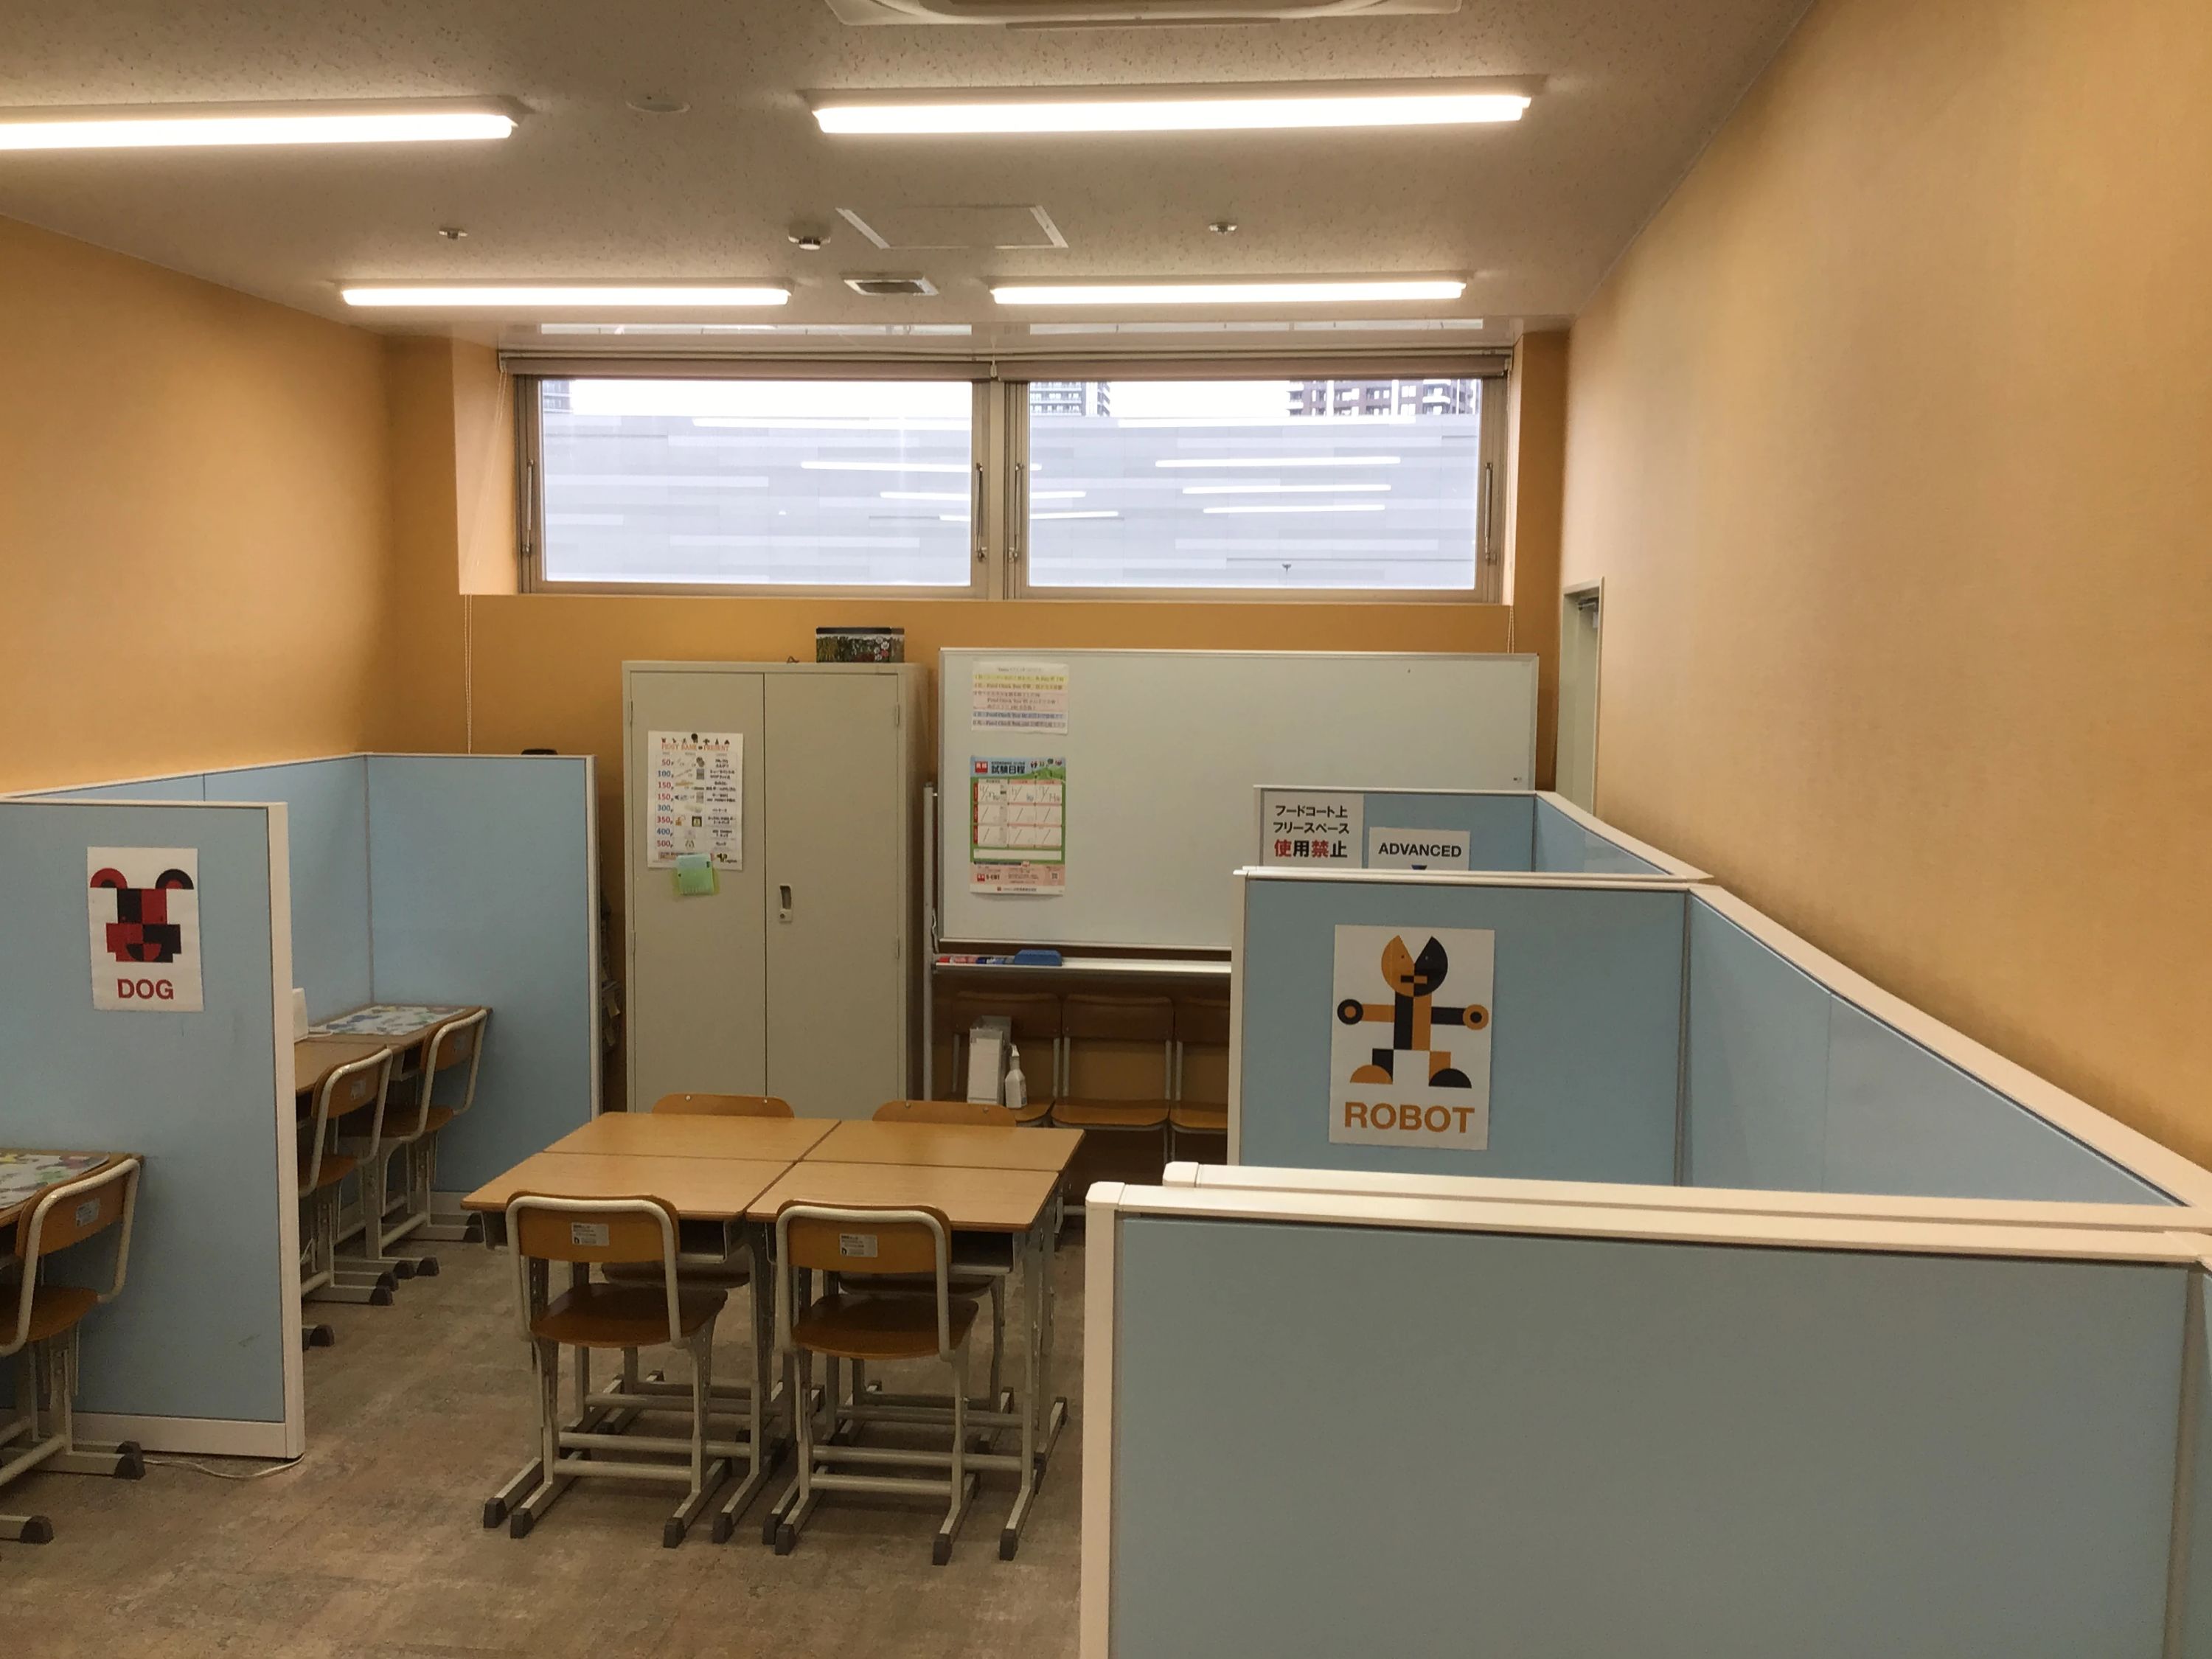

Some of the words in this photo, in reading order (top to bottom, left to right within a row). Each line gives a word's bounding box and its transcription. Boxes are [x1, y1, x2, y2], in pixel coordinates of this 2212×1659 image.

[1275, 805, 1348, 818] フードコート上
[1273, 821, 1350, 834] フリースペース
[1274, 839, 1348, 858] 使用禁止
[1378, 843, 1462, 858] ADVANCED
[117, 978, 174, 1000] DOG
[1344, 1102, 1475, 1133] ROBOT
